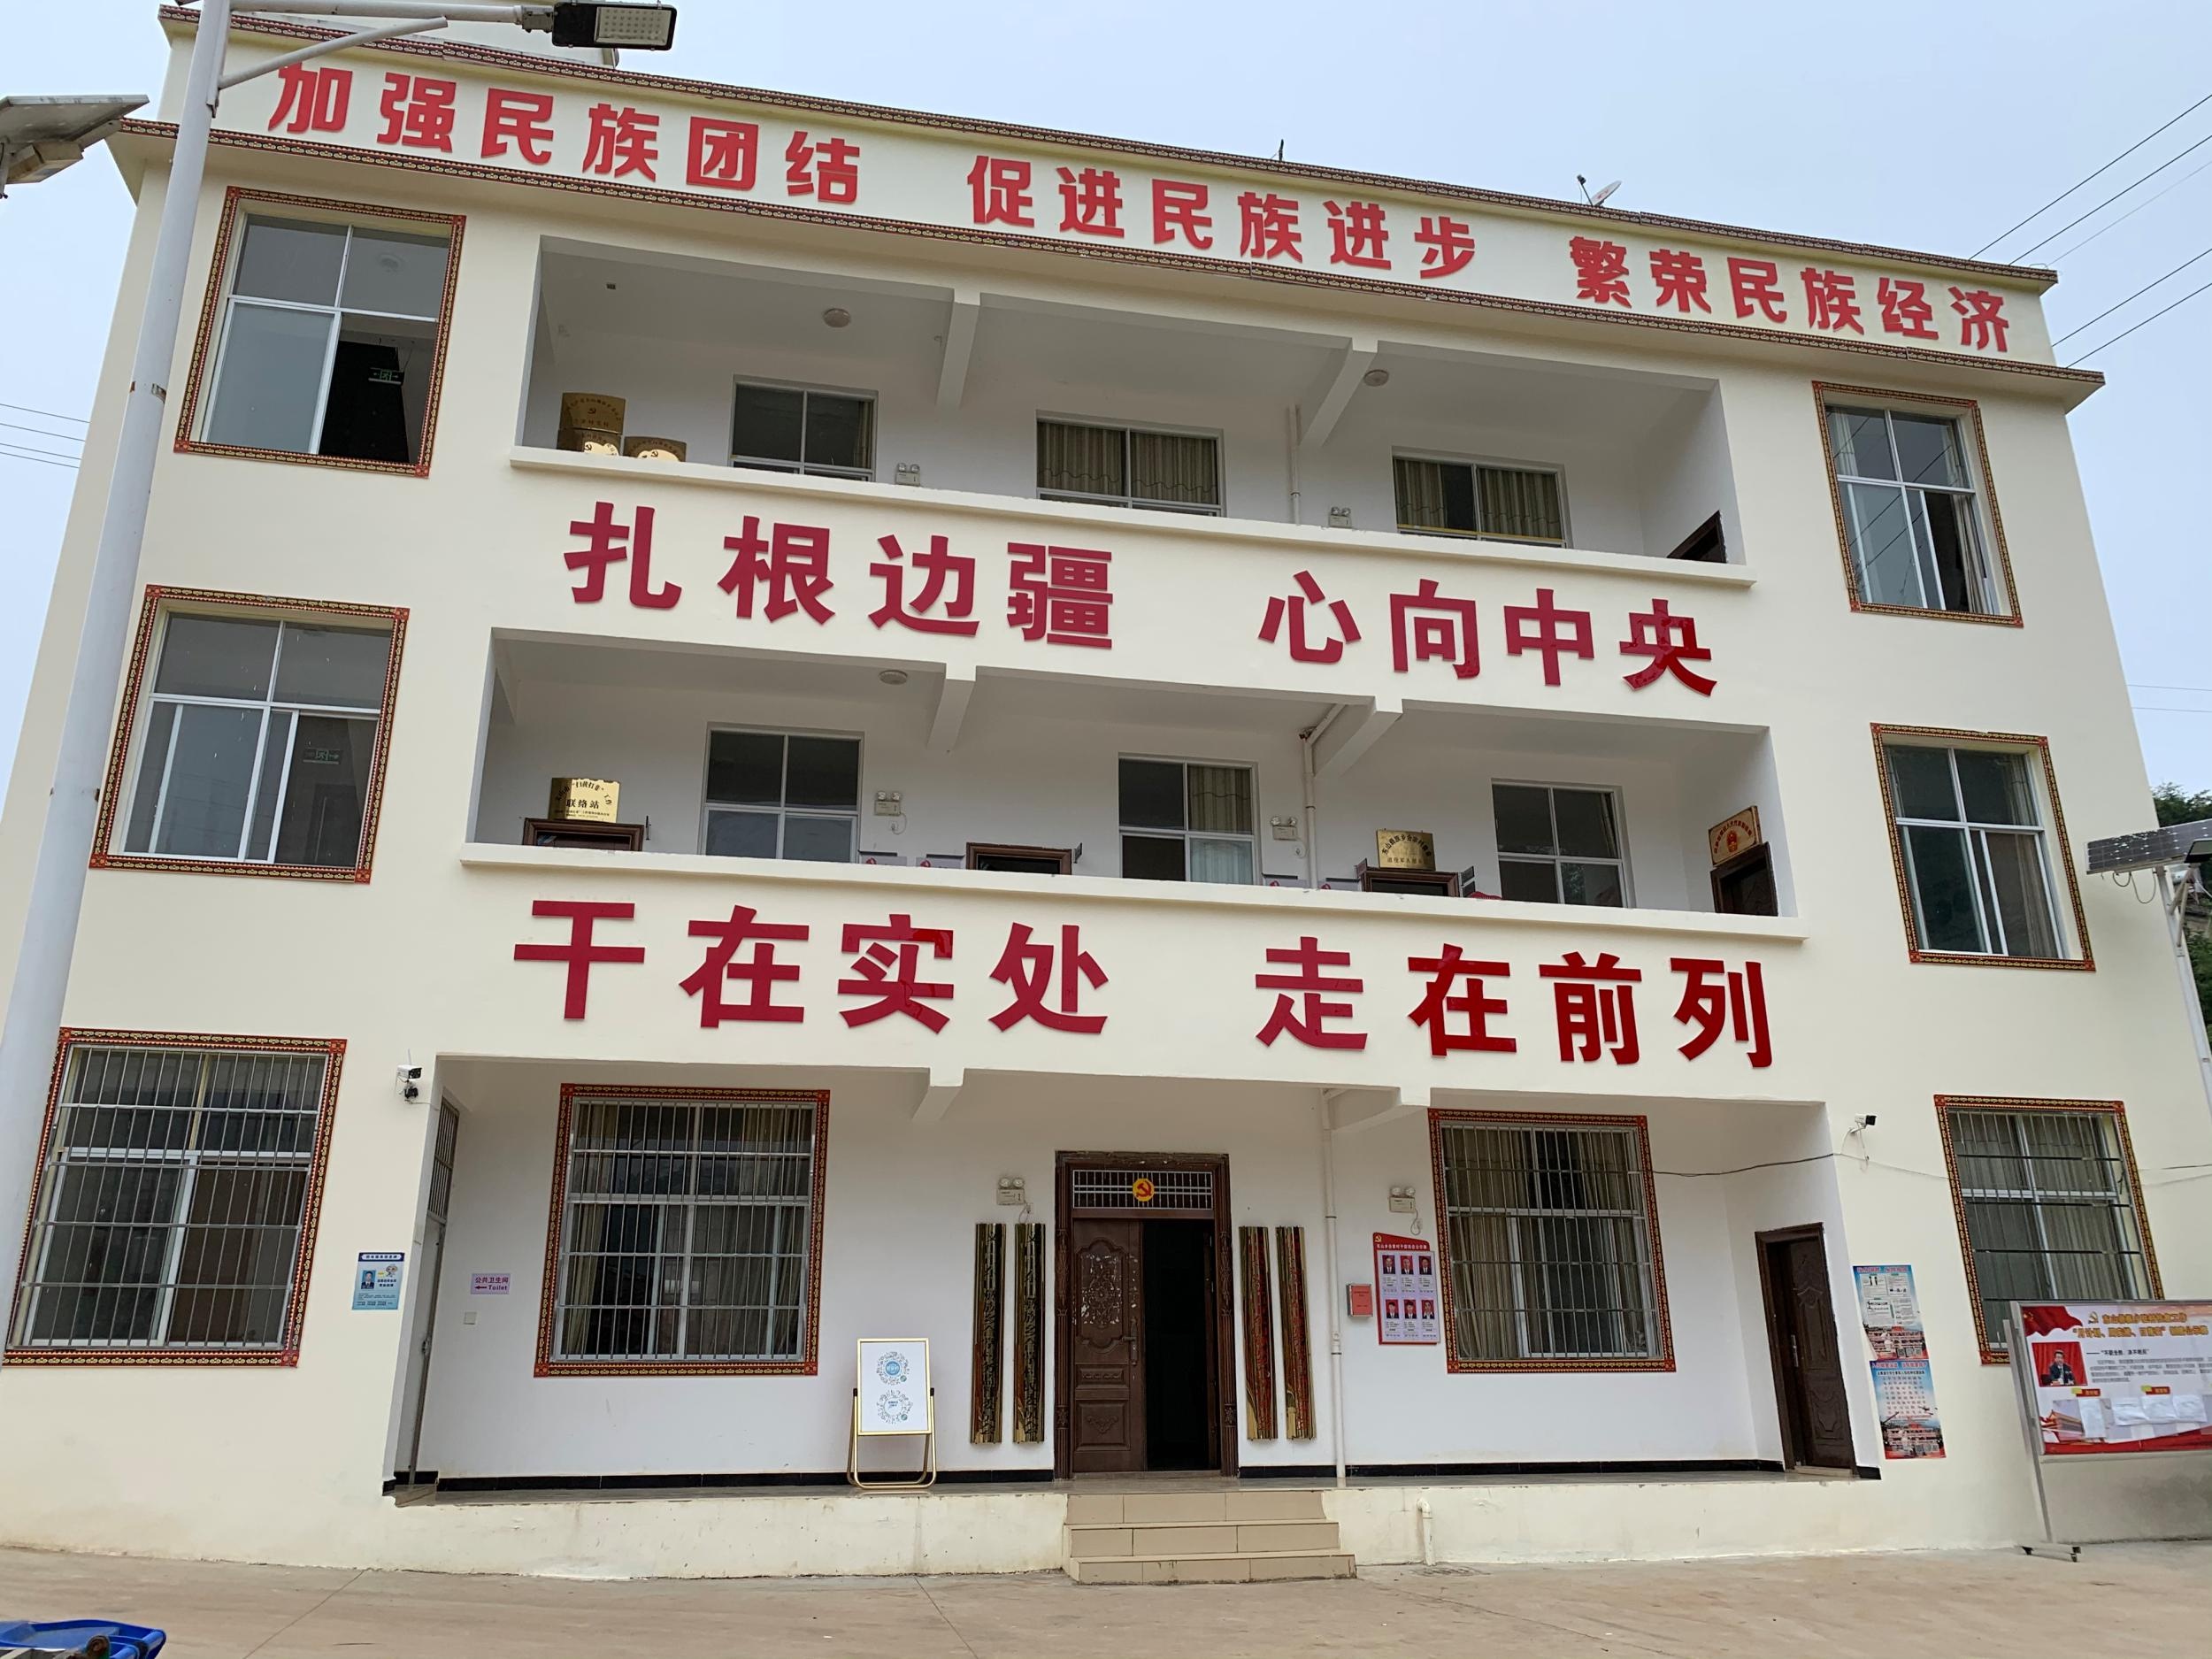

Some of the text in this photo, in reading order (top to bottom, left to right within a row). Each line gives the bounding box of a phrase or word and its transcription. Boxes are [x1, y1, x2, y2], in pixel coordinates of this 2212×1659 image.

[270, 63, 2008, 351] 加强民族团结 促进民族进步 繁荣民族经济
[565, 503, 1715, 695] 扎根边疆 心向中央
[515, 900, 1771, 1067] 干在实处 走在前列
